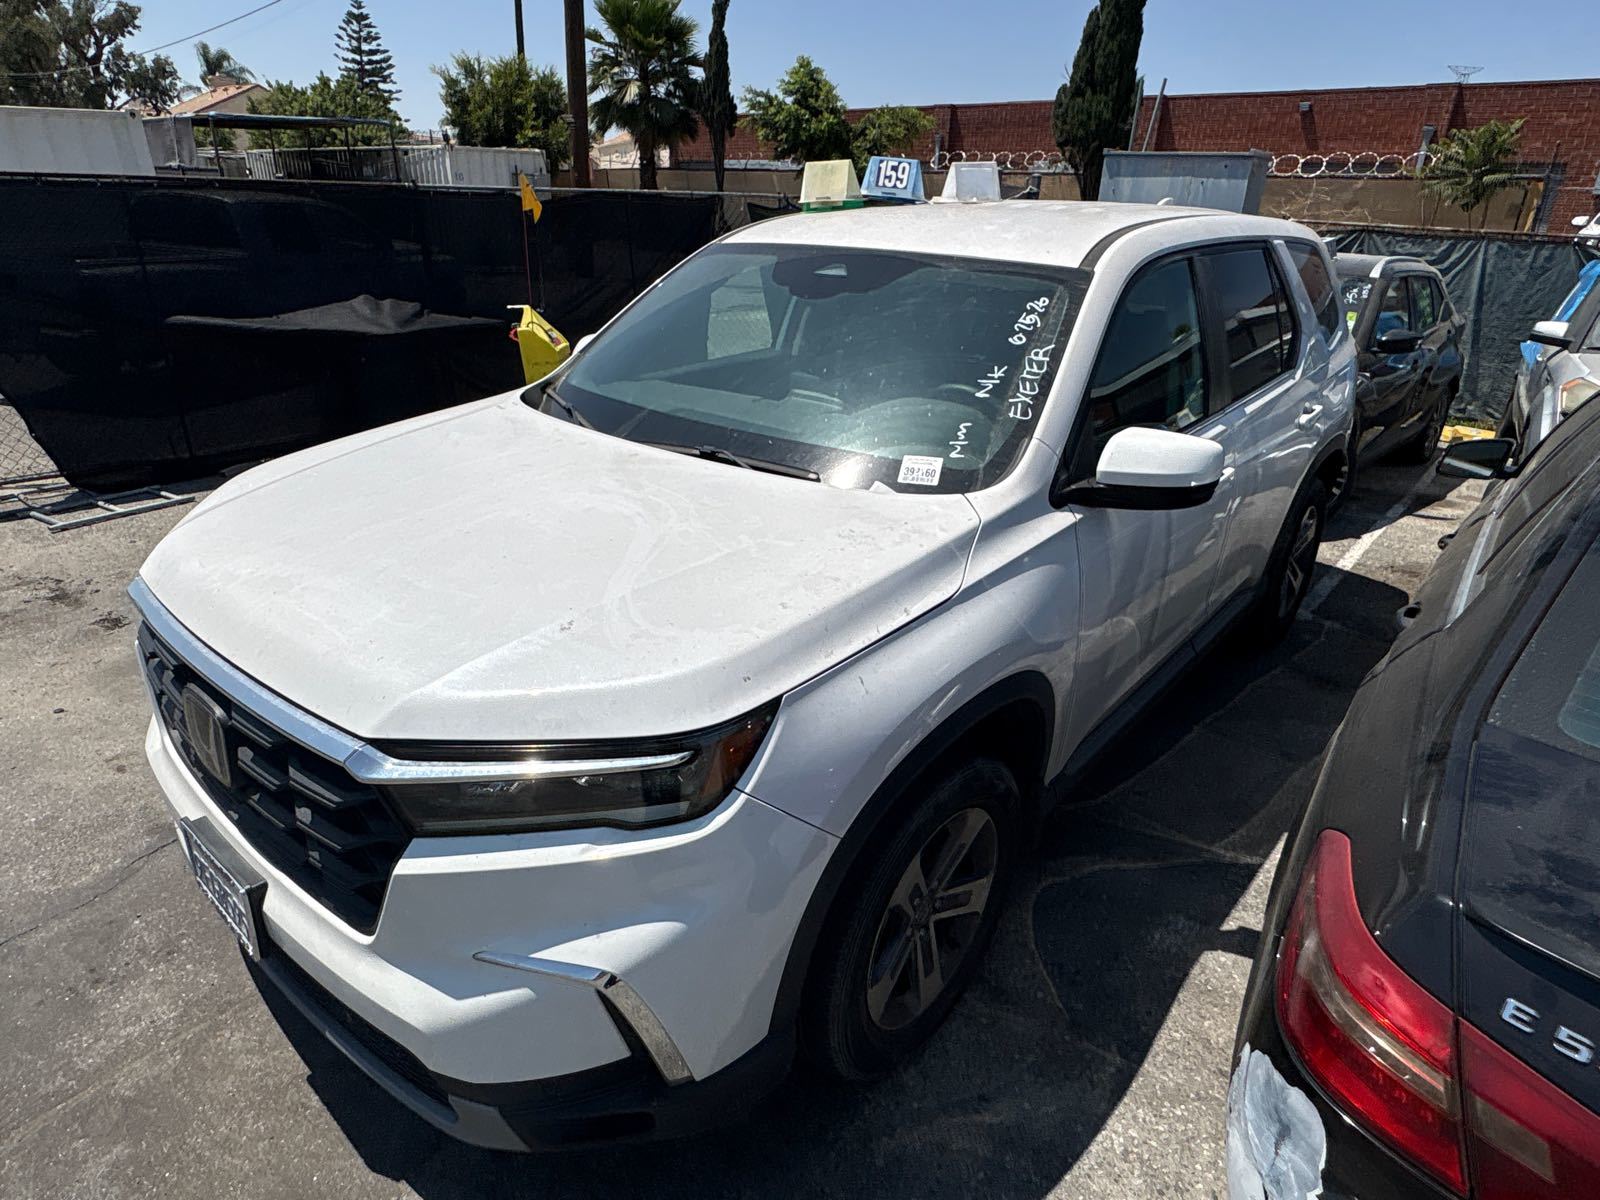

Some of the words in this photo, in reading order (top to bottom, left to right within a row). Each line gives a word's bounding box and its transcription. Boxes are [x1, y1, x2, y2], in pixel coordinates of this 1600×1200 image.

[878, 160, 910, 189] 159
[1008, 344, 1055, 420] EXETER
[1501, 997, 1541, 1034] E
[1552, 1024, 1600, 1070] 5
